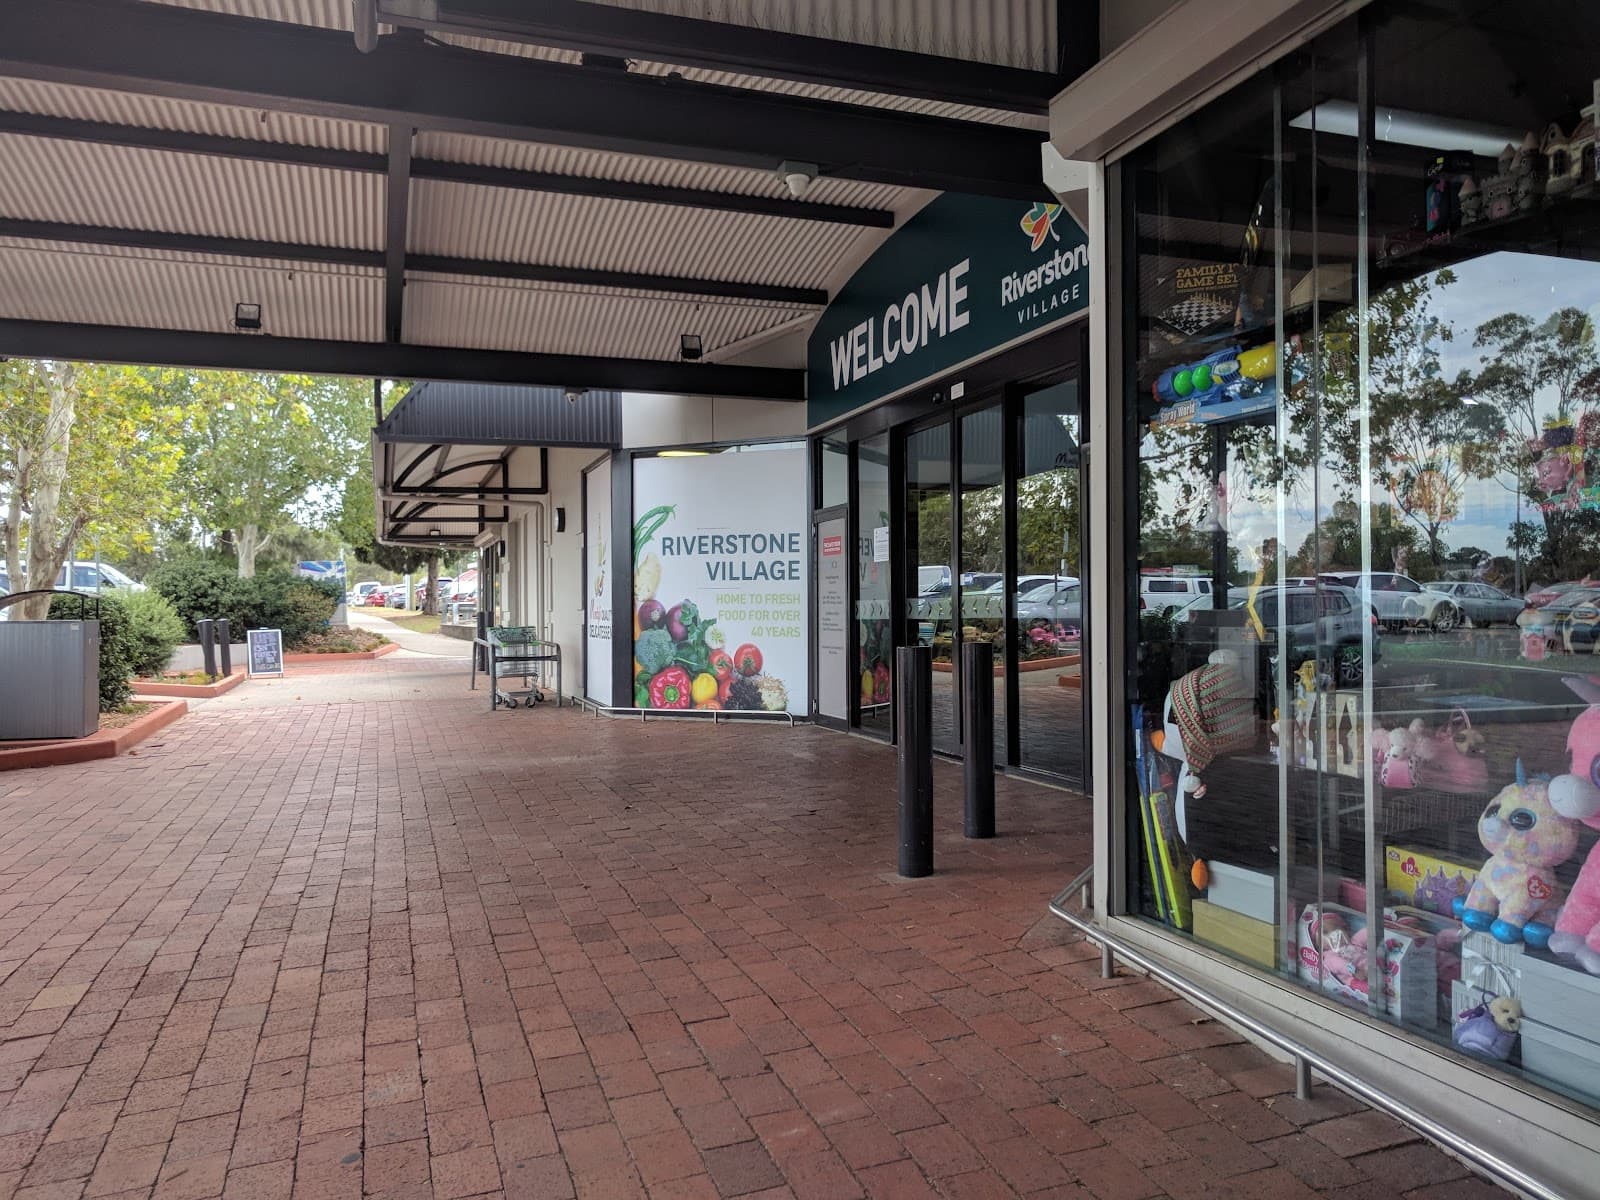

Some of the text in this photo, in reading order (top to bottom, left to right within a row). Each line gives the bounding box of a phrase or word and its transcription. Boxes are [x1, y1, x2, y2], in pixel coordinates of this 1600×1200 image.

[1001, 244, 1089, 307] Riverston
[1176, 265, 1224, 279] FAMILY
[1176, 275, 1214, 289] GAME
[1017, 284, 1080, 324] VILLAGE
[830, 258, 970, 391] WELCOME
[662, 533, 801, 556] RIVERSTONE
[706, 560, 801, 581] VILLAGE
[716, 592, 801, 605] HOME TO FRESH
[718, 610, 801, 622] FOOD FOR OVER
[751, 626, 801, 638] 40 YEARS
[1303, 948, 1319, 964] Baby
